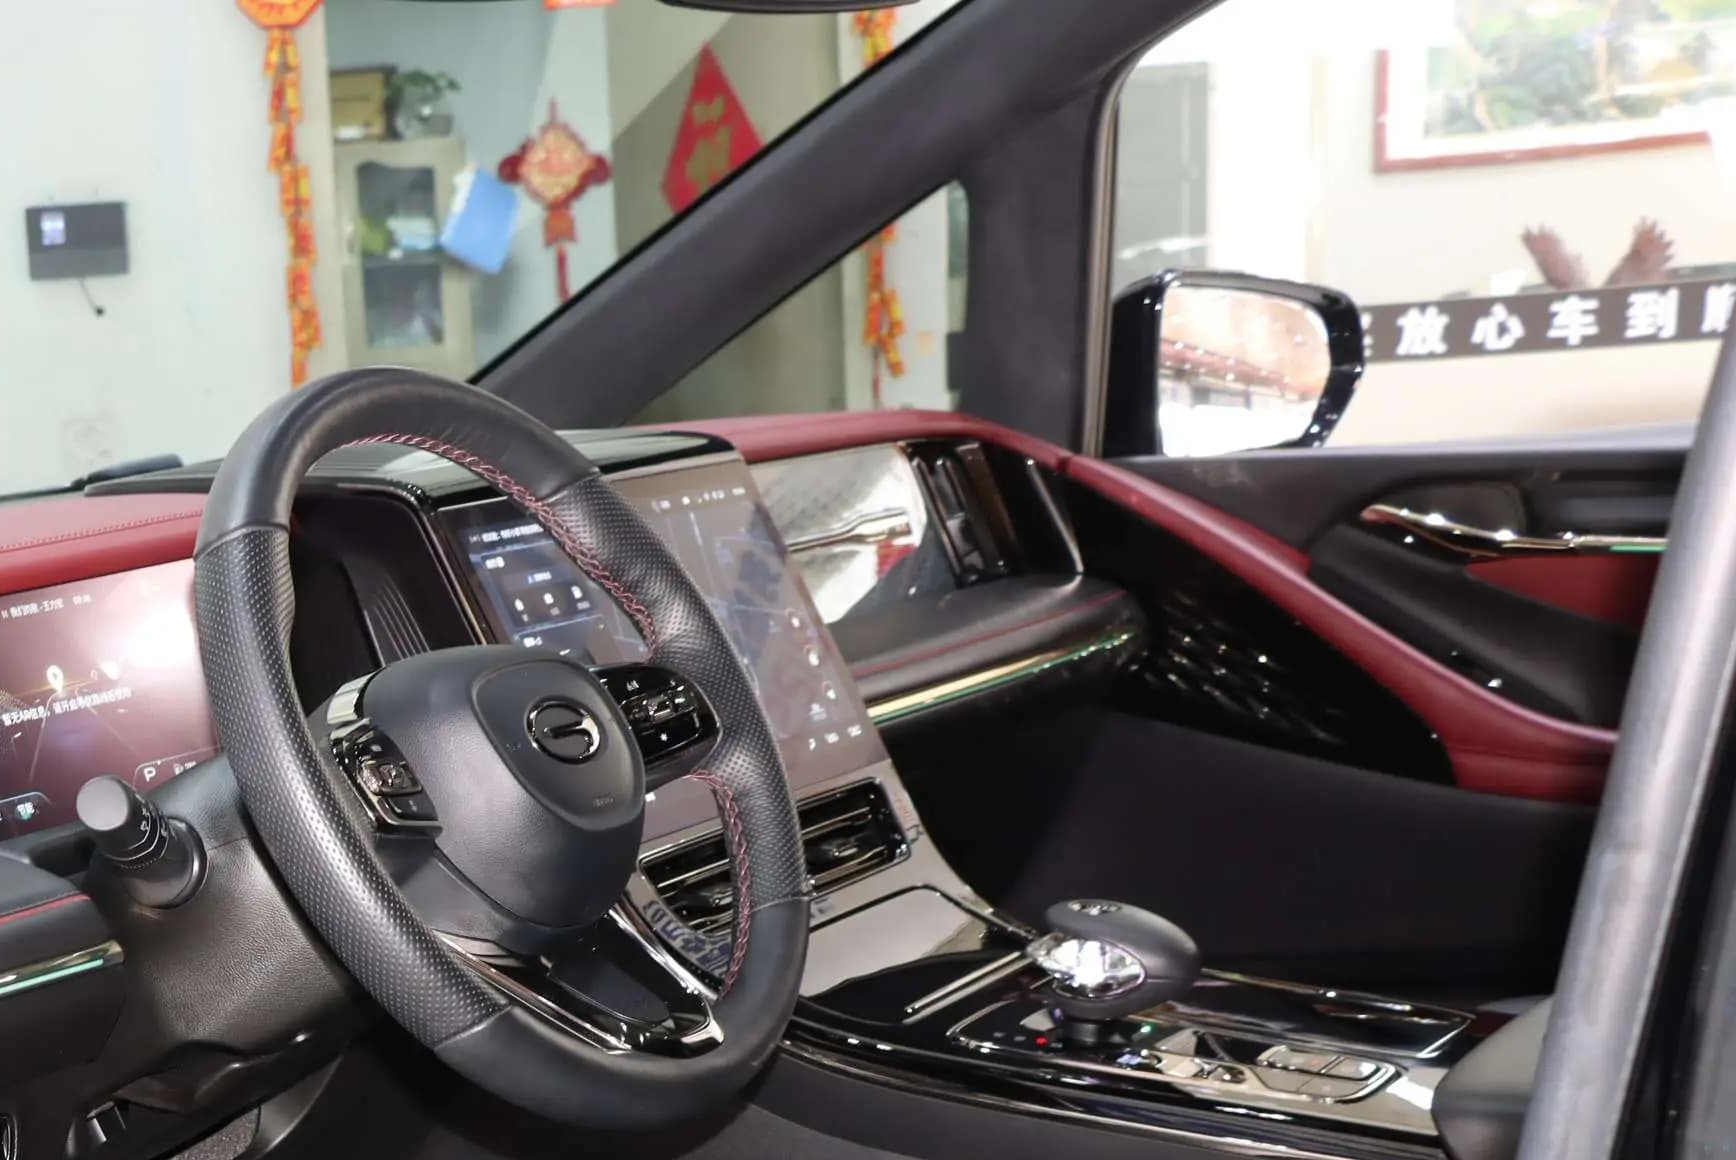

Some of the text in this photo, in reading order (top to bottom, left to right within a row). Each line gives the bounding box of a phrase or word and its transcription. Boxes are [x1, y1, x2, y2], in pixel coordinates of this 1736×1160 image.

[1361, 283, 1736, 356] 放心车到
[143, 766, 156, 782] P
